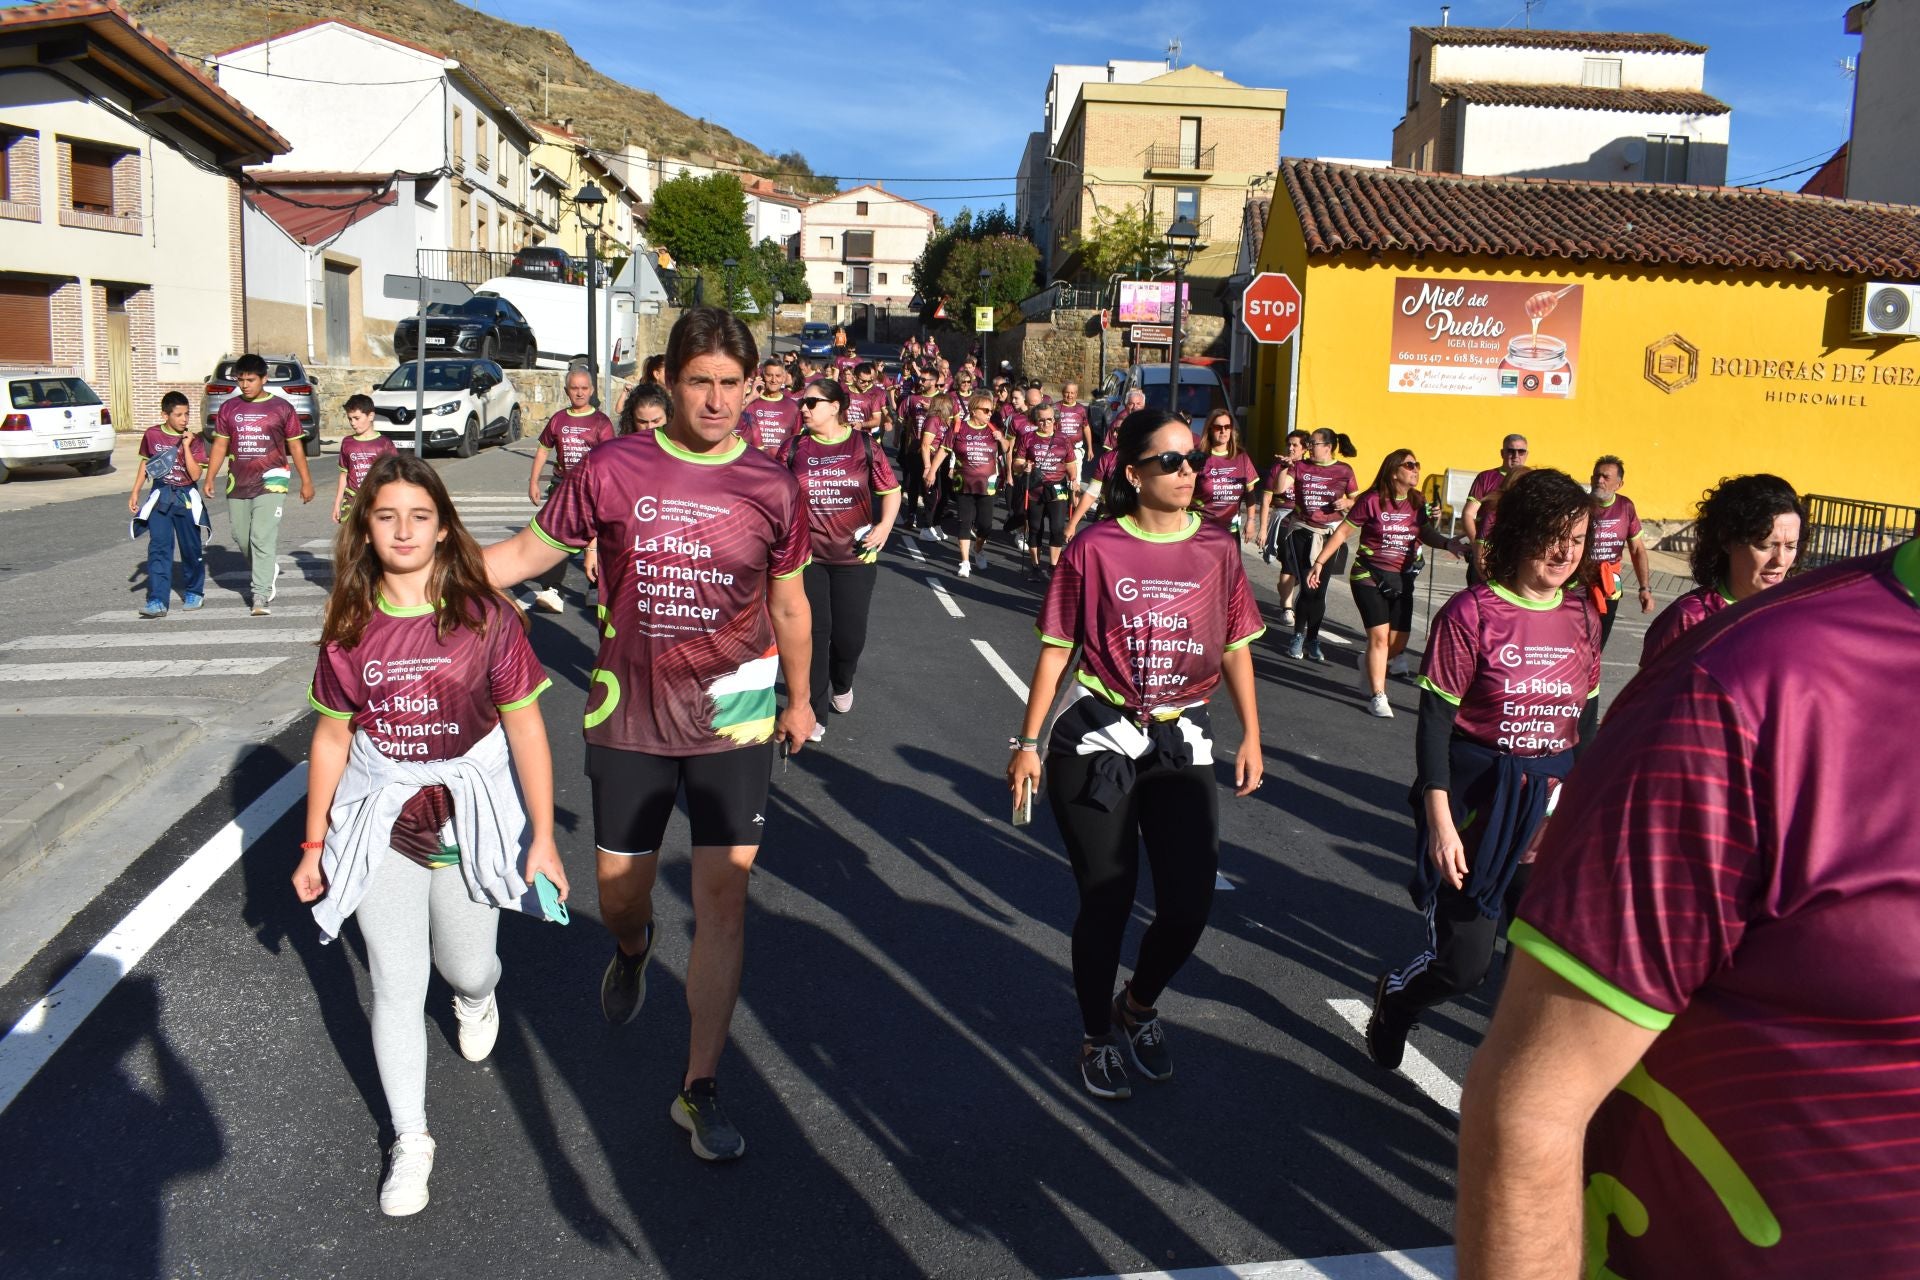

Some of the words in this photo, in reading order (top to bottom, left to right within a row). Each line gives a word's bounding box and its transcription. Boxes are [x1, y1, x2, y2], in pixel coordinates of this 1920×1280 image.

[1402, 283, 1464, 315] Miel
[1468, 294, 1489, 307] del
[1250, 300, 1296, 316] STOP
[1426, 309, 1505, 340] Pueblo
[1447, 339, 1466, 349] IGEA
[1467, 340, 1479, 350] (La
[1480, 341, 1500, 351] Rioja)
[1398, 352, 1415, 360] 660
[1416, 353, 1428, 361] 115
[1429, 354, 1442, 363] 417
[1453, 353, 1467, 362] 618
[1469, 354, 1483, 364] 854
[1484, 356, 1499, 364] 401
[1710, 356, 1826, 382] BODEGAS
[1832, 364, 1866, 384] DE
[1765, 391, 1868, 407] HIDROMIEL
[808, 469, 820, 477] La
[822, 468, 846, 477] Rioja
[808, 479, 821, 487] En
[823, 478, 860, 488] marcha
[808, 488, 841, 496] contra
[662, 499, 699, 509] asociación
[699, 503, 730, 515] española
[809, 497, 820, 505] el
[820, 496, 853, 505] cáncer
[662, 506, 684, 514] contra
[691, 510, 717, 519] cáncer
[680, 515, 698, 525] Rioja
[634, 535, 658, 552] La
[663, 535, 712, 560] Rioja
[635, 560, 658, 578] En
[662, 565, 735, 586] marcha
[637, 581, 696, 600] contra
[637, 599, 651, 614] el
[654, 600, 720, 621] cáncer
[1121, 614, 1144, 629] La
[1148, 612, 1188, 631] Rioja
[1126, 636, 1145, 652] En
[1149, 638, 1204, 655] marcha
[387, 657, 420, 667] asociación
[387, 666, 409, 674] contra
[1504, 678, 1527, 694] La
[1531, 678, 1572, 697] Rioja
[368, 699, 390, 713] La
[394, 694, 439, 715] Rioja
[1503, 701, 1525, 717] En
[375, 718, 393, 735] En
[395, 720, 460, 737] marcha
[1499, 718, 1555, 733] contra
